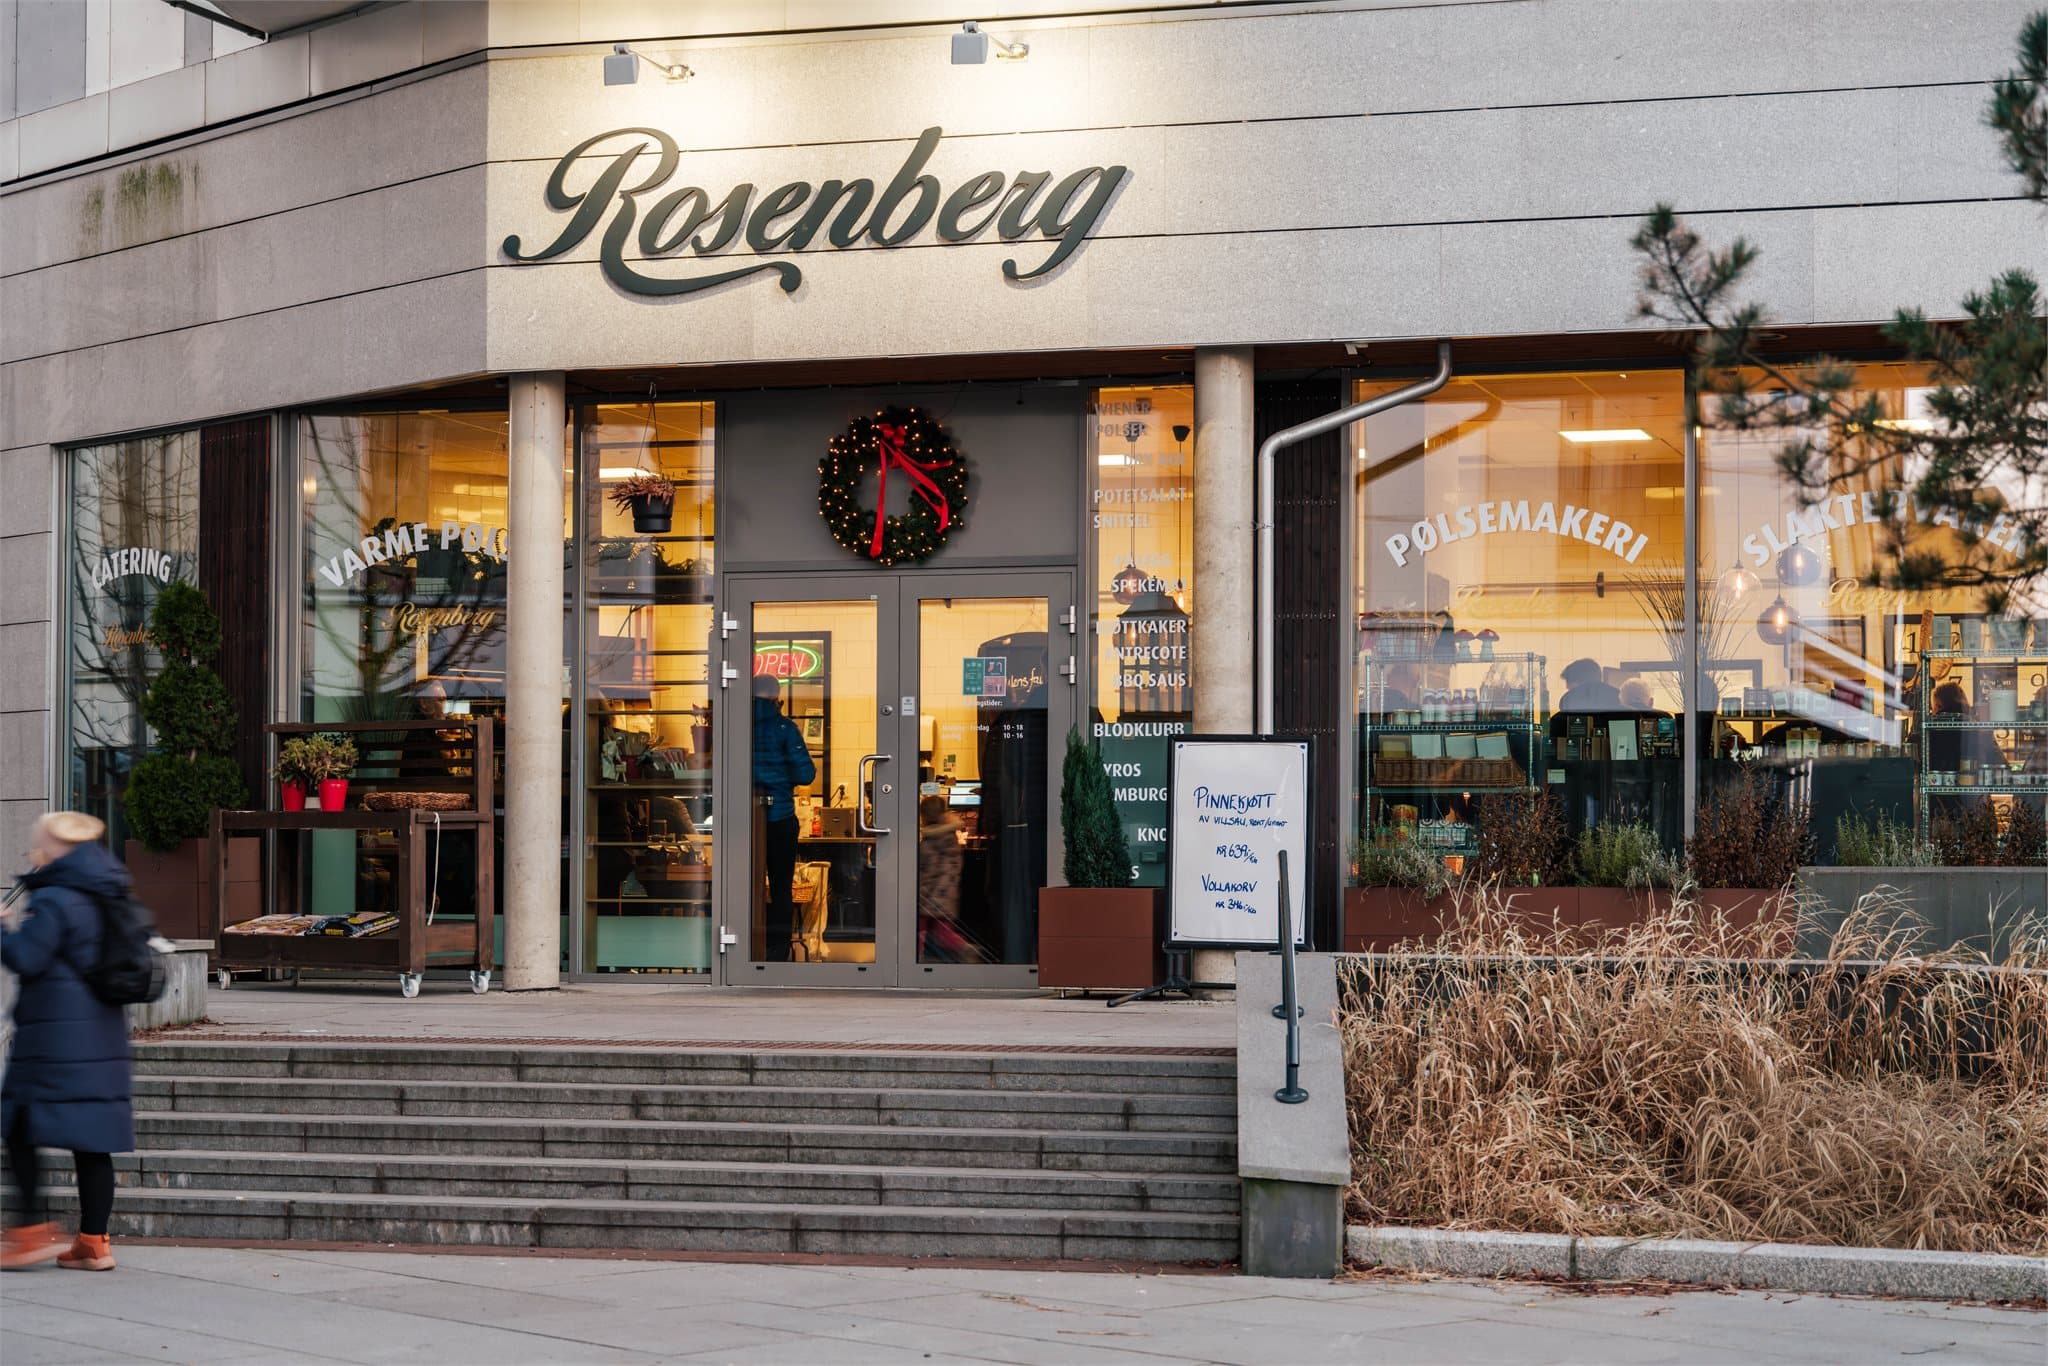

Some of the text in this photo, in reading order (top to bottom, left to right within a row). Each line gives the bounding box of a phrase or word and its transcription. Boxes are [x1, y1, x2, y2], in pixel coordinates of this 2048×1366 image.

[503, 126, 1127, 296] Rosenberg
[1094, 401, 1151, 416] WIENER
[1096, 423, 1149, 438] PØLSER
[1094, 487, 1186, 504] POTETSALAT
[1094, 513, 1149, 529] SNITSEL
[1385, 500, 1649, 568] PØLSEMAKERI
[319, 522, 430, 588] VARME
[92, 546, 172, 590] CATERING
[1112, 577, 1187, 593] SPEKEMAT
[1112, 672, 1187, 690] BBQ SAUS
[1093, 722, 1185, 738] BLODKLUBB
[1102, 763, 1142, 777] YROS
[1193, 786, 1277, 815] PINNEKJØTT
[1198, 814, 1210, 824] AV
